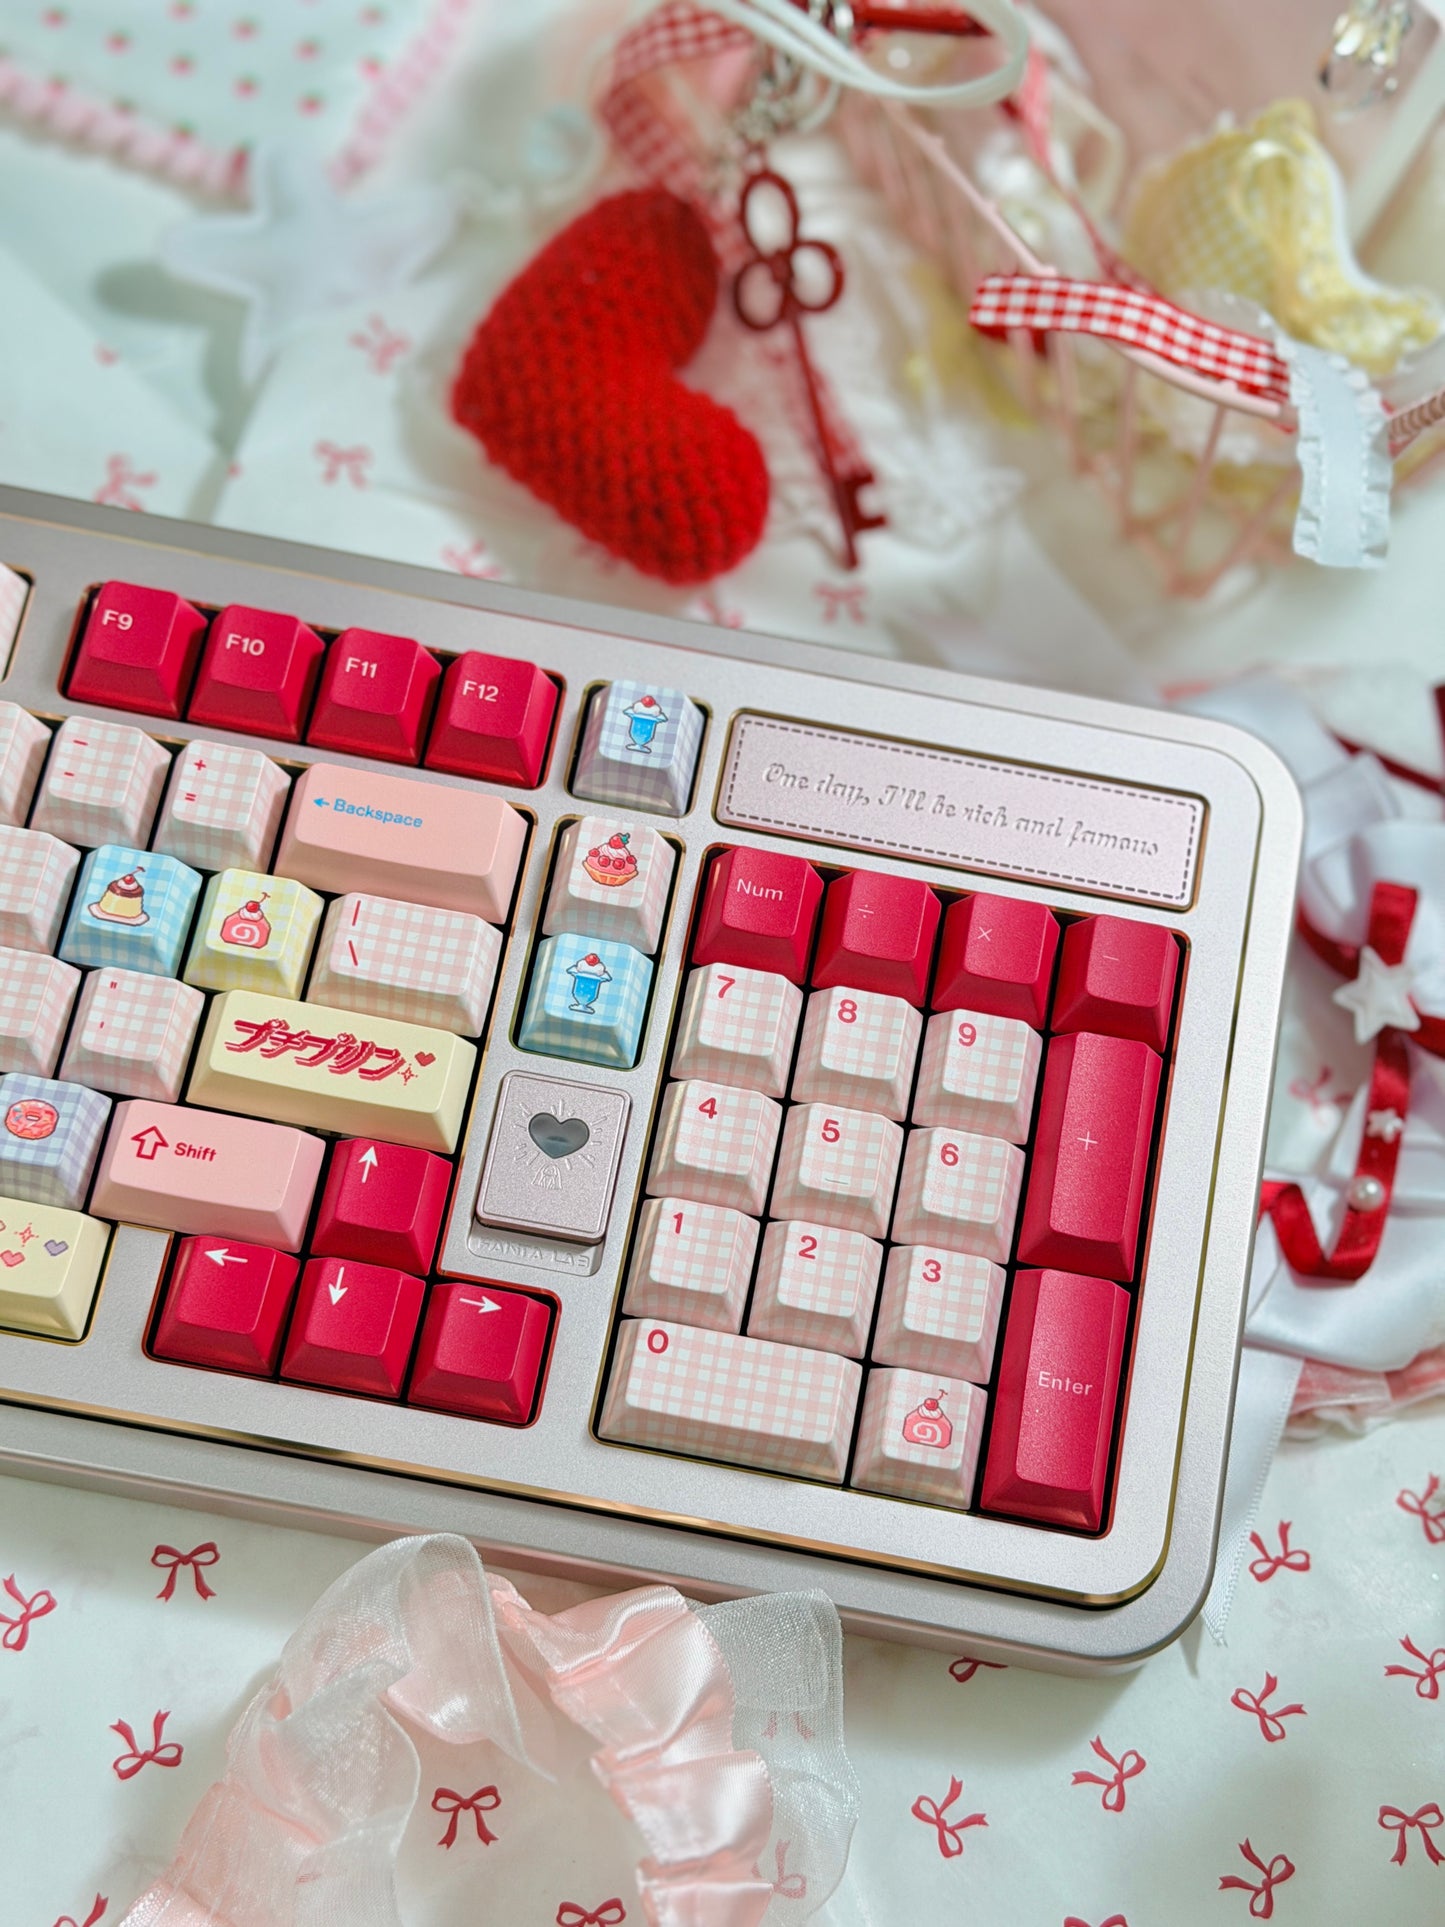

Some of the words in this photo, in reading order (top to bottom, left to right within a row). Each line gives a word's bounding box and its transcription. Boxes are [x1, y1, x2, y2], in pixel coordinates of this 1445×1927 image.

[102, 609, 133, 631] F9
[225, 633, 265, 656] F10
[345, 656, 378, 678] F11
[462, 679, 499, 702] F12
[332, 798, 424, 829] Backspace
[762, 762, 809, 789] One
[815, 773, 870, 806] day,
[878, 784, 926, 812] I'll
[929, 794, 956, 818] be
[962, 804, 1008, 829] rich
[1014, 816, 1064, 838] and
[1066, 820, 1160, 857] famous
[736, 878, 784, 902] Num
[716, 975, 736, 999] 7
[837, 999, 858, 1024] 8
[957, 1022, 977, 1047] 9
[698, 1097, 718, 1120] 4
[820, 1119, 840, 1143] 5
[173, 1140, 217, 1163] Shift
[940, 1143, 960, 1167] 6
[672, 1212, 684, 1235] 1
[798, 1235, 818, 1260] 2
[921, 1259, 942, 1283] 3
[647, 1328, 669, 1354] 0
[1037, 1370, 1094, 1396] Enter
